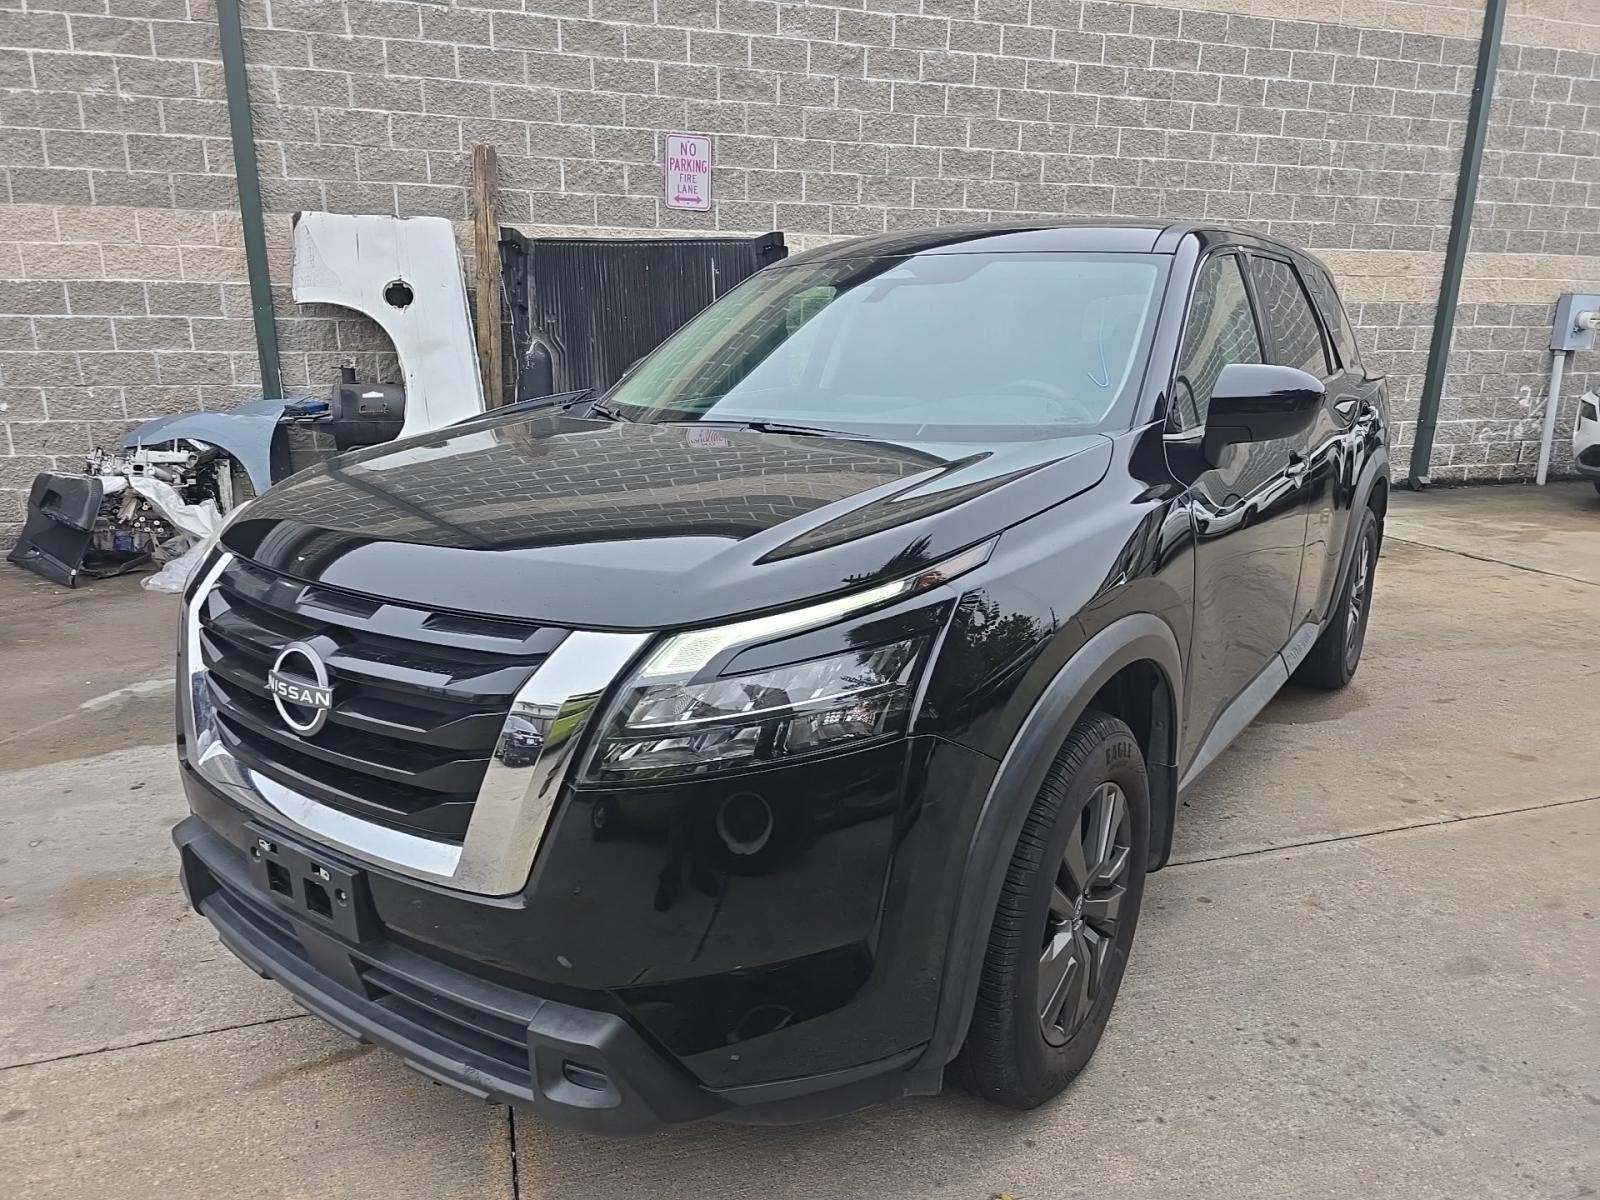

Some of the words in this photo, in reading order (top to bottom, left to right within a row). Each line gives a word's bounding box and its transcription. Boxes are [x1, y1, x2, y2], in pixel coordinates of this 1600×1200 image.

[680, 142, 697, 157] NO
[669, 157, 707, 174] PARKING
[680, 173, 697, 184] FIRE
[677, 184, 699, 195] LANE
[268, 672, 330, 707] NISSAN
[1105, 741, 1132, 766] EAGLE
